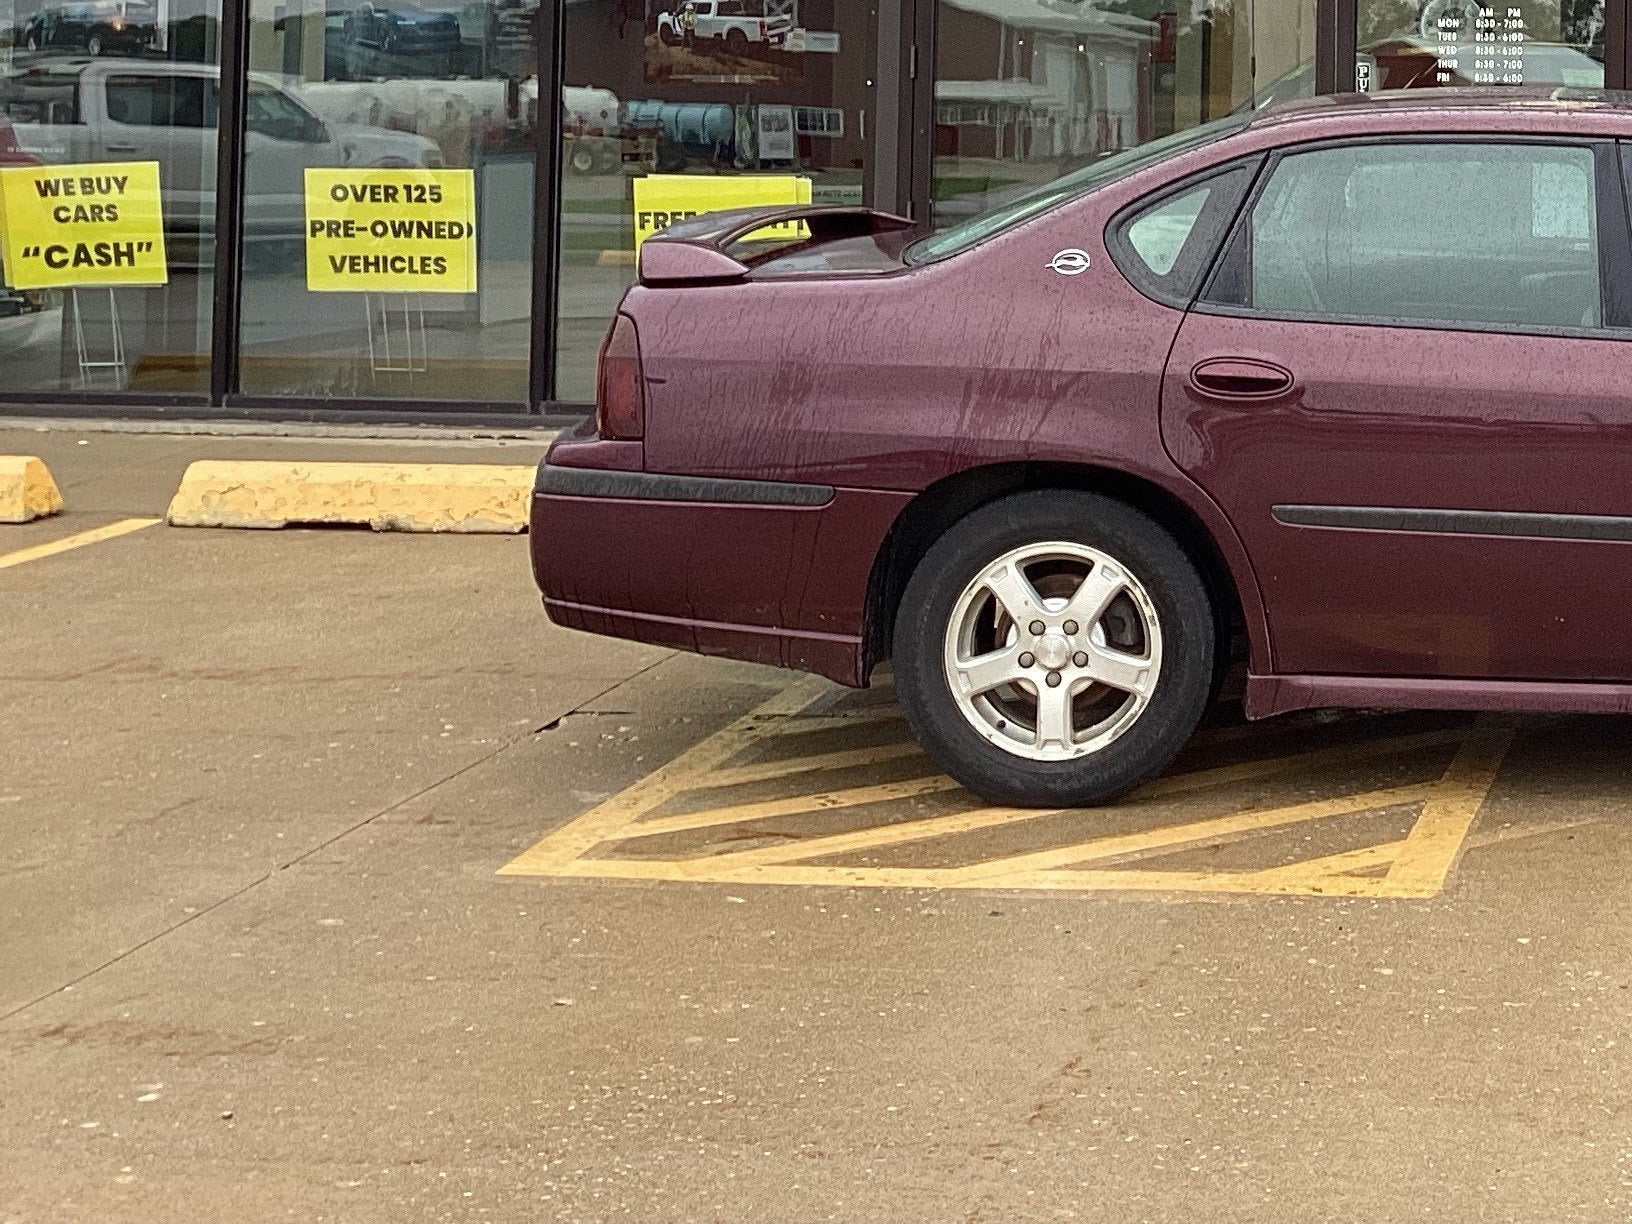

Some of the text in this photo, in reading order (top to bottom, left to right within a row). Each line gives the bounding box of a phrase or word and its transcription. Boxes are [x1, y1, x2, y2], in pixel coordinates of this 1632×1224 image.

[1479, 8, 1521, 17] AM PM
[1437, 18, 1460, 28] MON
[1438, 46, 1458, 55] WED
[1437, 59, 1458, 68] THUR
[1436, 73, 1450, 82] FRI
[35, 175, 129, 198] WE BUY
[330, 184, 443, 203] OVER 125
[53, 203, 119, 224] CARS
[310, 219, 464, 240] PRE-OWNED
[22, 241, 153, 270] "CASH"
[328, 254, 447, 275] VEHICLES
